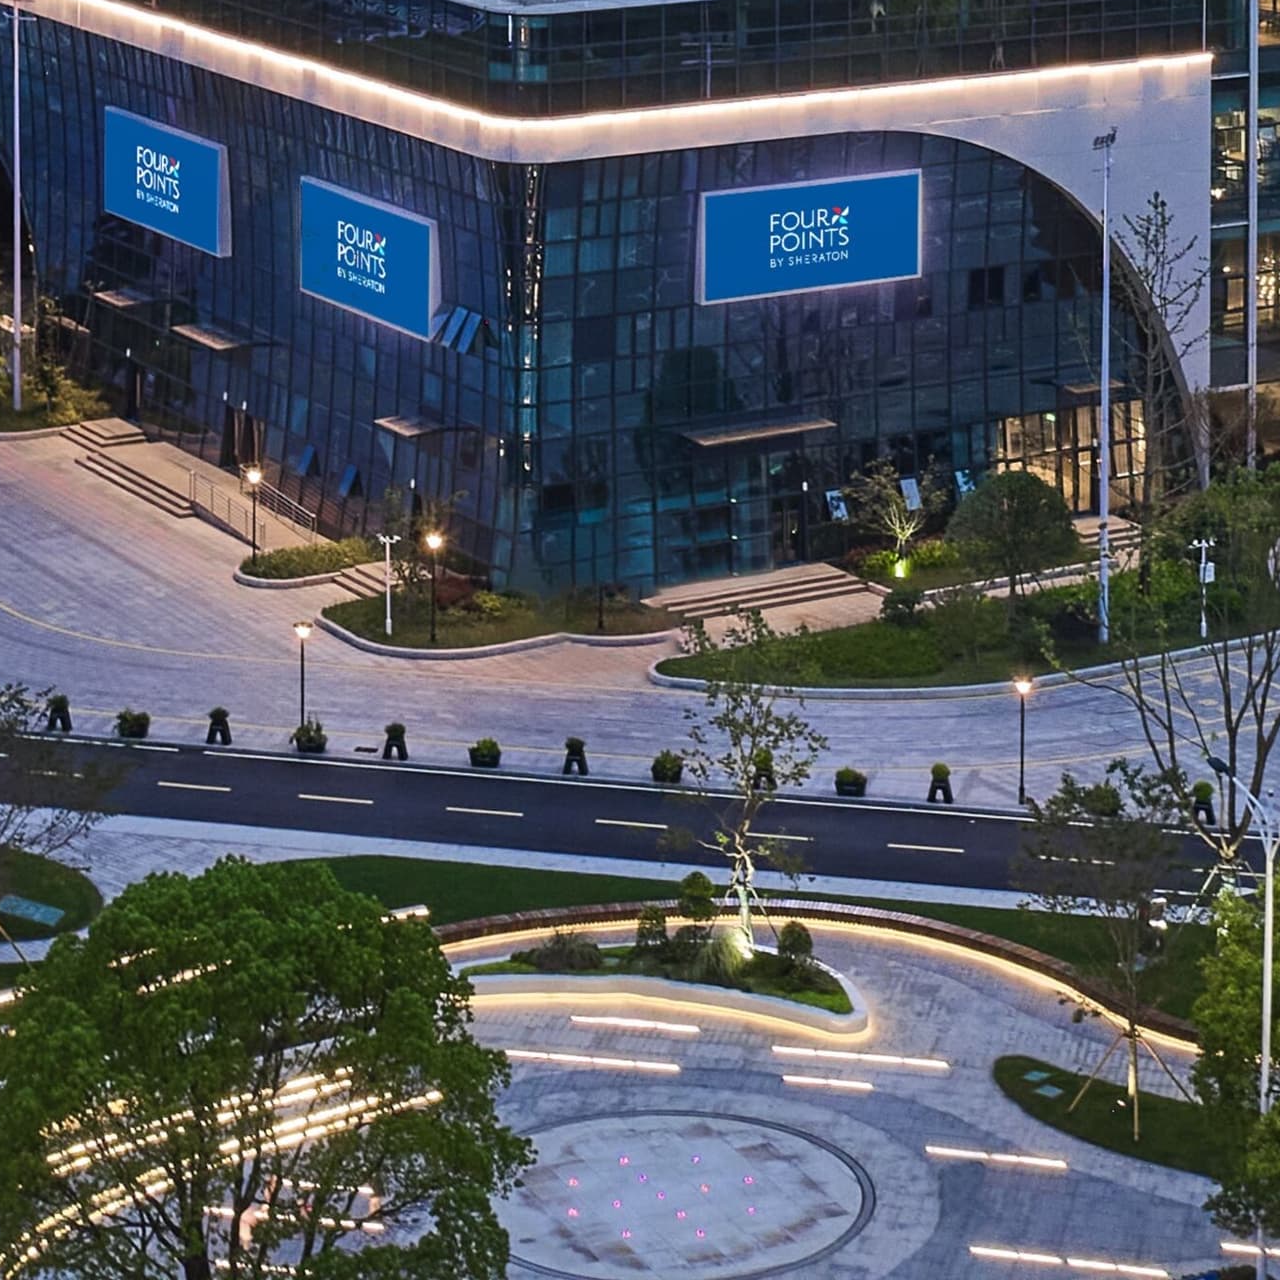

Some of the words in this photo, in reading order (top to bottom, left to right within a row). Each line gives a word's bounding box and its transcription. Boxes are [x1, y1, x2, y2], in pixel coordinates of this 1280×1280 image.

[136, 145, 171, 175] FOUR
[136, 165, 180, 200] POINTS
[770, 208, 831, 231] FOUR
[337, 220, 376, 253] FOUR
[770, 226, 849, 254] POINTS
[337, 241, 386, 279] POINTS
[770, 258, 784, 269] BY
[788, 249, 849, 266] SHERATON
